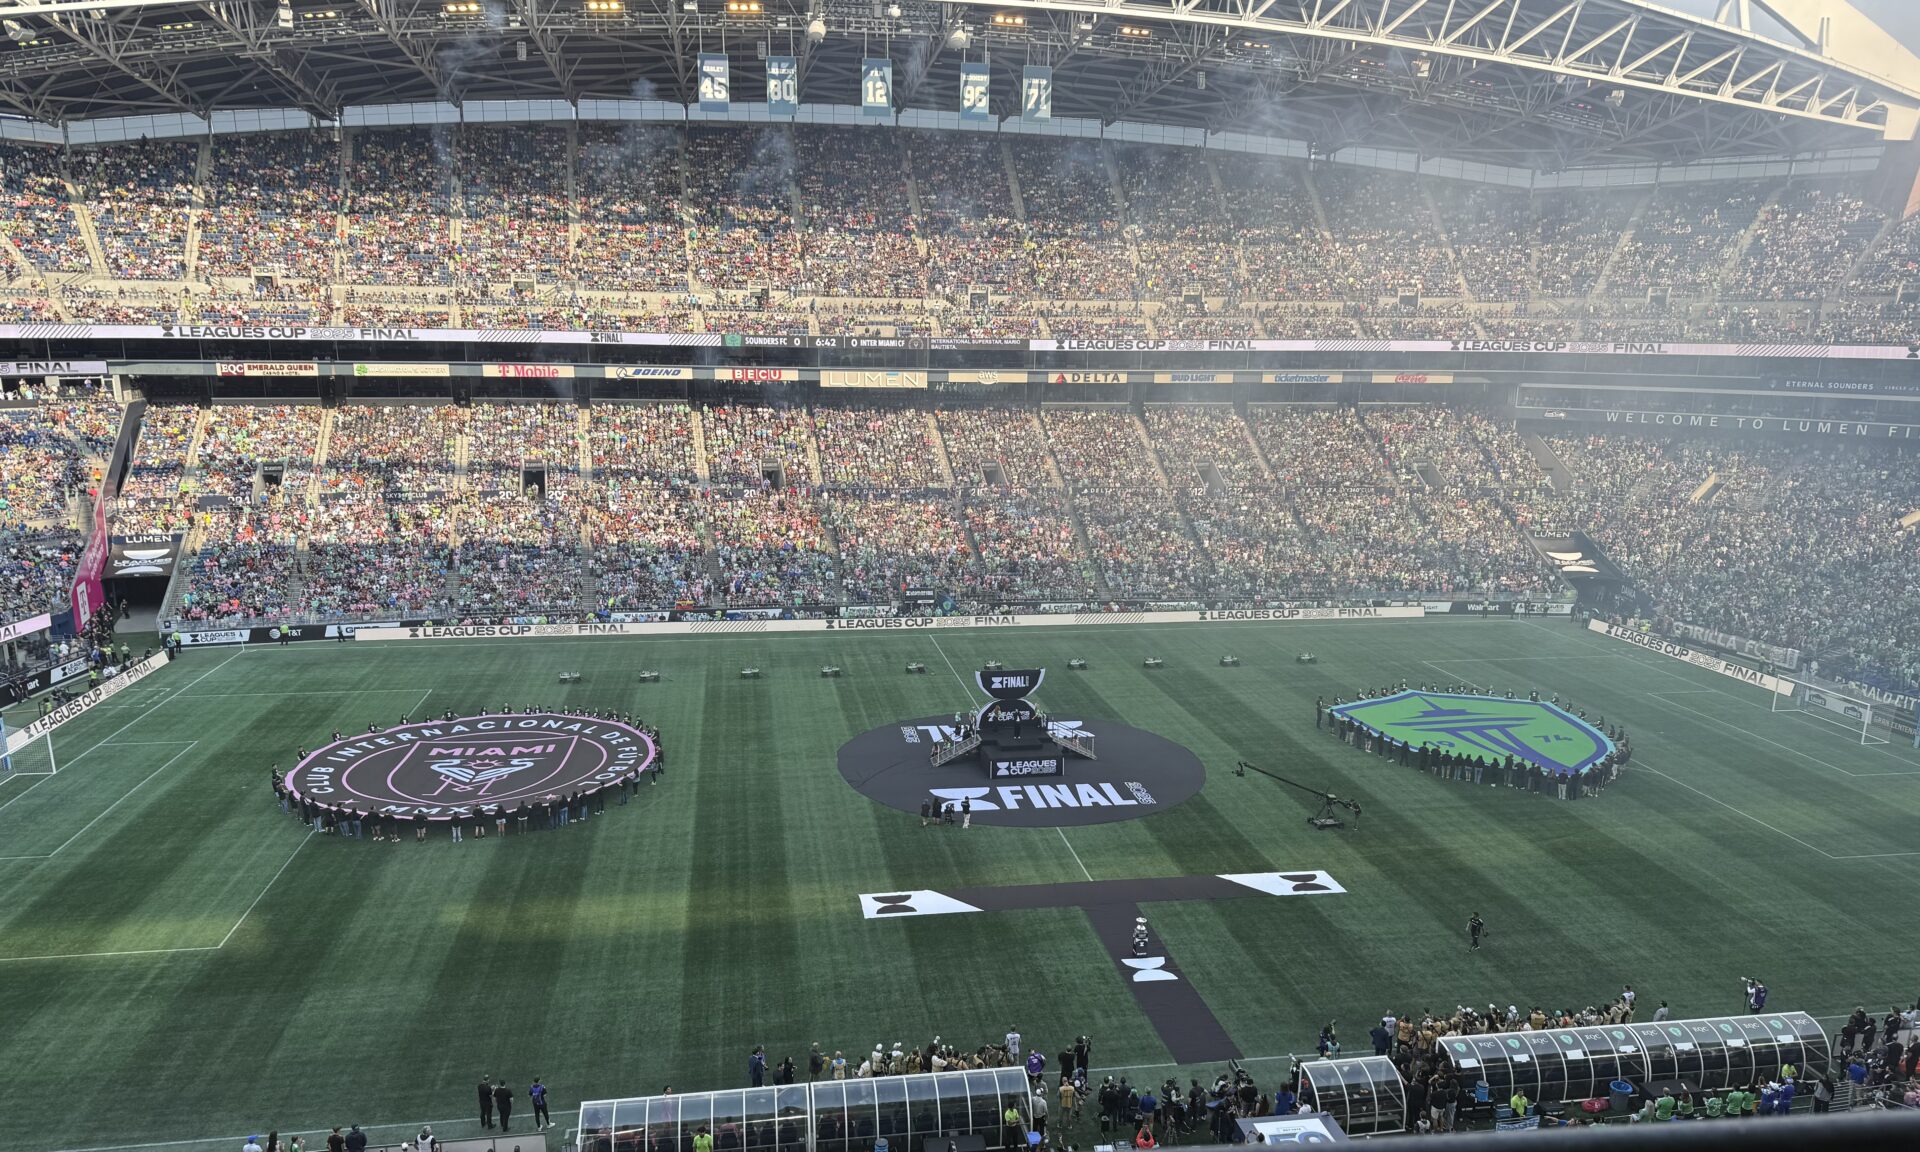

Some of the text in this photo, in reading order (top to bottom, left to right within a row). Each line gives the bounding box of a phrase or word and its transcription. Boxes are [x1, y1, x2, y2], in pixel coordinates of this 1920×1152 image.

[700, 77, 728, 99] 45
[769, 79, 795, 101] 80
[866, 81, 887, 103] 12
[963, 86, 987, 108] 96
[1027, 89, 1047, 111] 71
[179, 326, 419, 340] LEAGUES CUP 2025 FINAL
[600, 332, 620, 342] FINAL
[745, 337, 788, 345] SOUNDERS FC
[794, 338, 801, 346] 0
[815, 338, 836, 346] 6:42
[1068, 340, 1256, 350] LEAGUES CUP 2025 FINAL
[1463, 341, 1668, 353] LEAGUES CUP 2025 FINAL
[16, 363, 79, 373] FINAL
[221, 364, 244, 373] EQC
[515, 365, 559, 377] Mobile
[733, 368, 782, 380] BECU
[829, 372, 919, 386] LUMEN
[977, 371, 999, 380] aws
[1071, 373, 1121, 383] DELTA
[1171, 374, 1216, 382] BUD LIGHT
[1274, 373, 1330, 383] ticketmaster
[1785, 381, 1824, 389] ETERNAL
[1828, 382, 1874, 390] SOUNDERS
[1606, 412, 1920, 438] WELCOME TO LUMEN FI
[126, 535, 172, 543] LUMEN
[1210, 608, 1382, 620] LEAGUES CUP 2025 FINAL
[838, 615, 1020, 628] LEAGUES CUP 2025 FINAL
[423, 623, 630, 637] LEAGUES CUP 2025 FINAL
[1613, 627, 1767, 687] LEAGUES CUP 2025 FINAL
[1003, 676, 1026, 688] FINAL
[34, 661, 156, 734] LEAGUES CUP 2025 FINAL
[306, 766, 334, 793] CLUB
[328, 719, 600, 762] INTERNACIONAL
[601, 731, 631, 745] DE
[429, 744, 556, 757] MIAMI
[1010, 760, 1057, 768] LEAGUES
[996, 782, 1138, 810] FINAL
